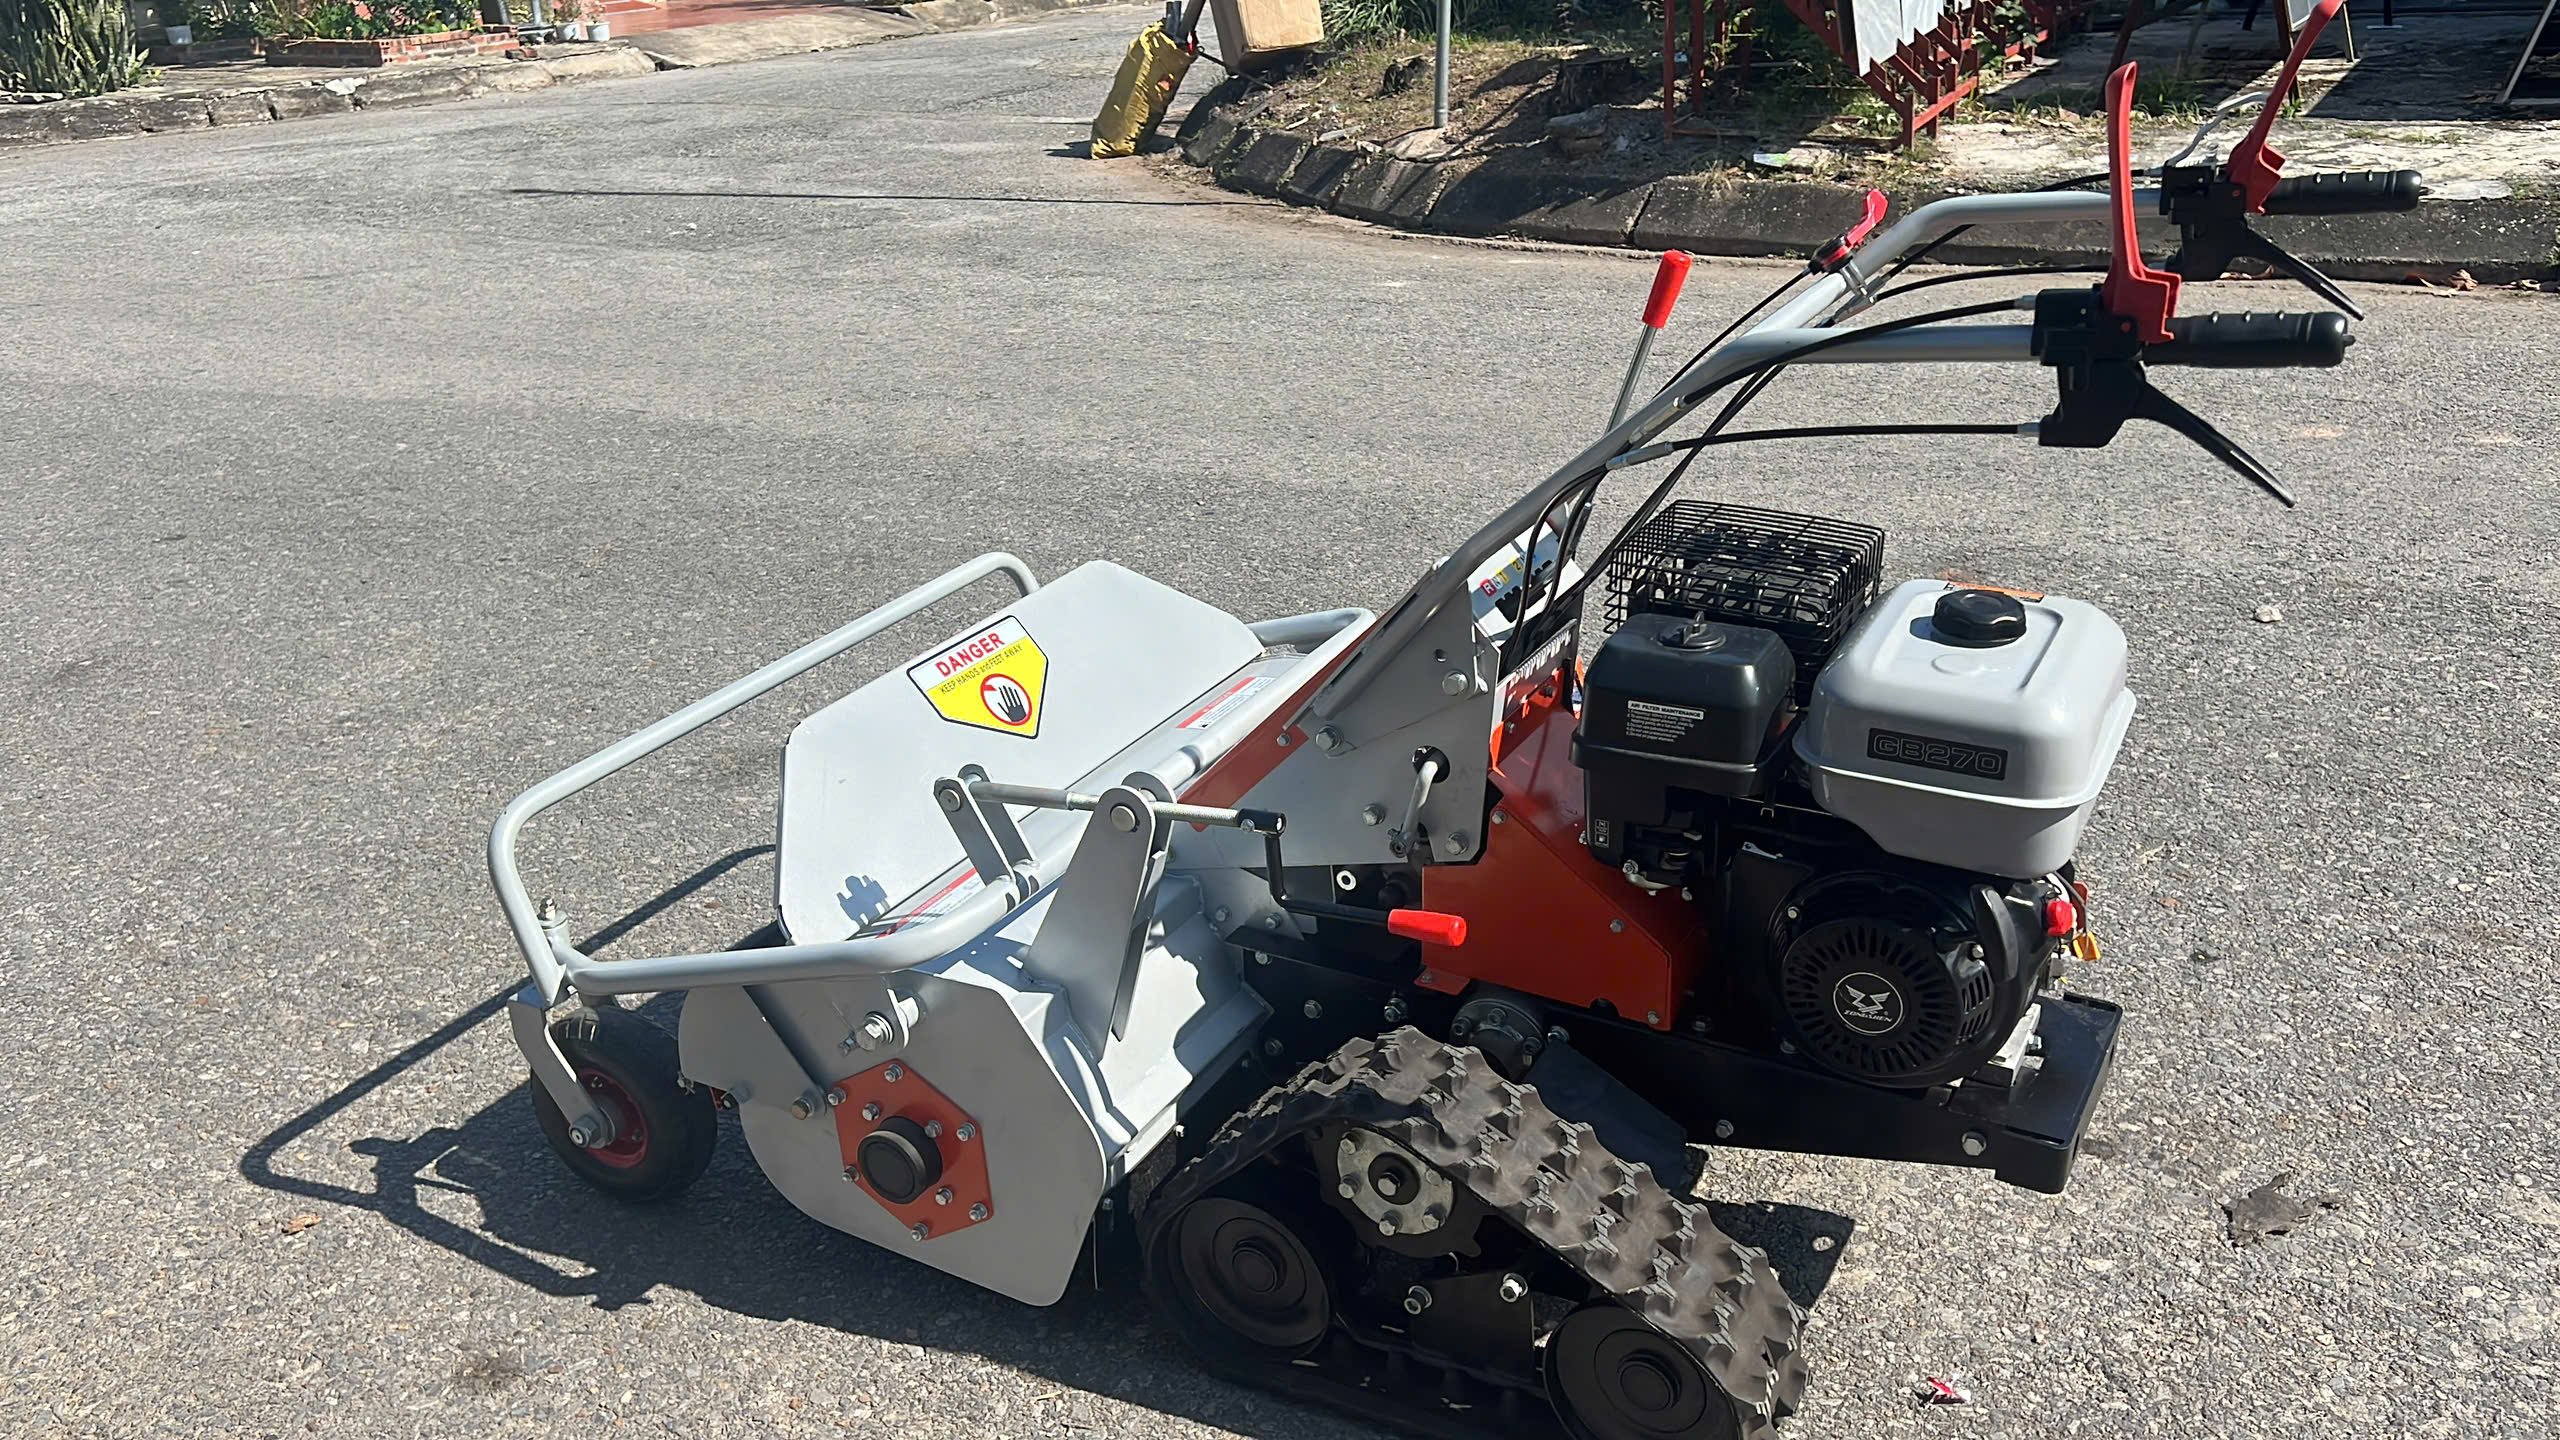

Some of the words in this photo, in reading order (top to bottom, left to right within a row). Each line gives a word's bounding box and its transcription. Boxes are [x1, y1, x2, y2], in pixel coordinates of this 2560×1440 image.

[1482, 581, 1495, 594] R
[935, 633, 1005, 677] DANGER
[940, 680, 956, 694] KEEP
[956, 667, 980, 685] HANDS
[989, 654, 1004, 668] FEET
[1004, 644, 1023, 658] AWAY
[1661, 707, 1701, 717] MAINTENANCE
[1873, 734, 2002, 774] GB270
[1843, 1010, 1892, 1022] ZONGSHEN
